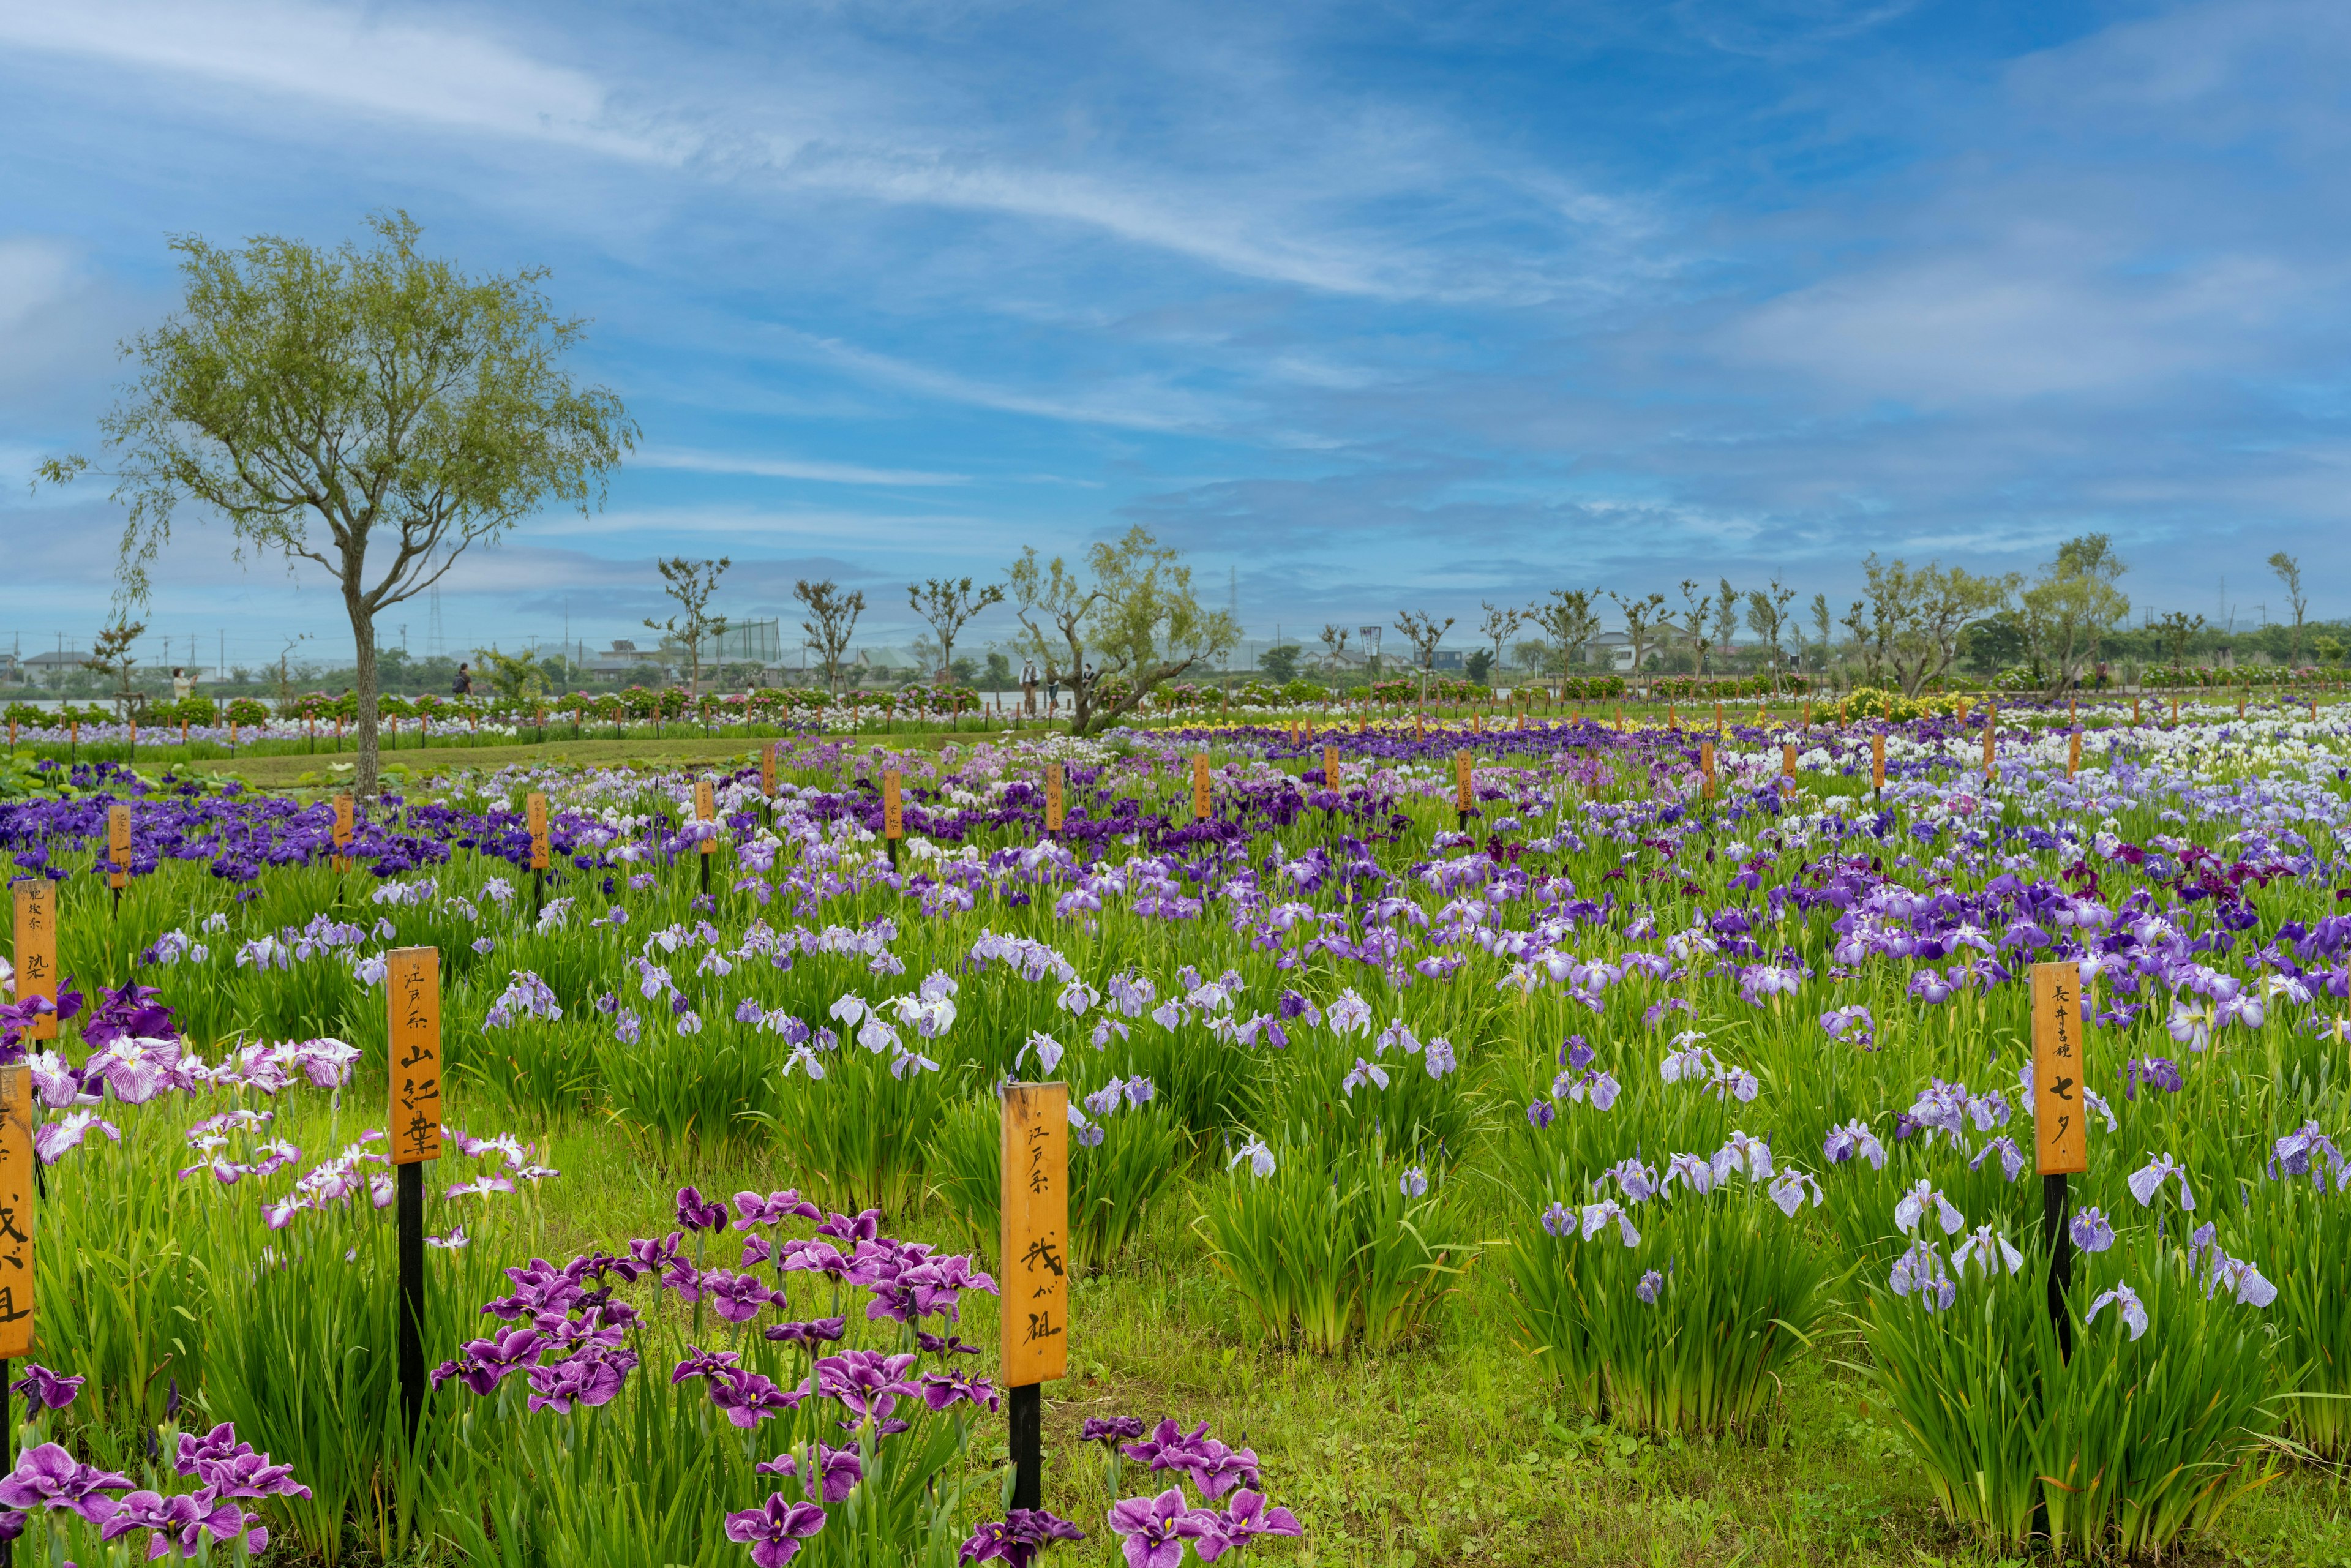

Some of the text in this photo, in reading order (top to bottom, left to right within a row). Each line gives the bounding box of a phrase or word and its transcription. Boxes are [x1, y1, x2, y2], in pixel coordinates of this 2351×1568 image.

[29, 888, 45, 930] 肥後系
[401, 972, 439, 1155] 江戸系 山紅葉
[2050, 985, 2074, 1145] 長井古種 七夕
[1020, 1125, 1064, 1346] 江戸系 我が祖
